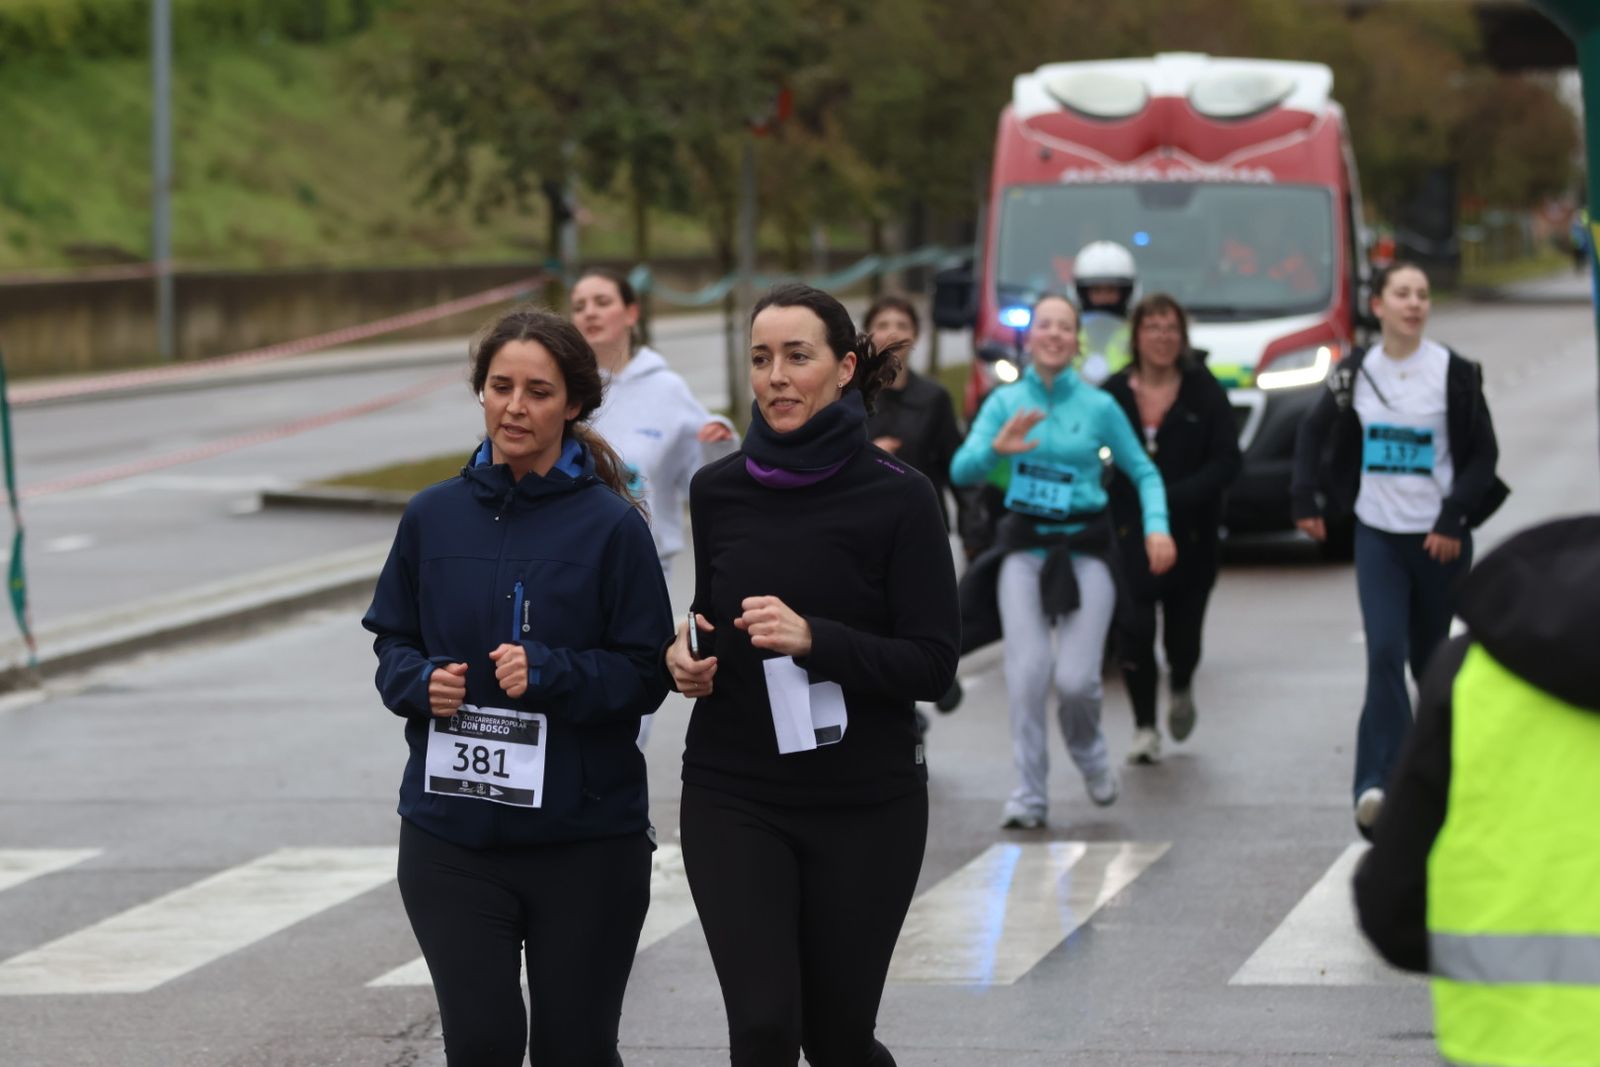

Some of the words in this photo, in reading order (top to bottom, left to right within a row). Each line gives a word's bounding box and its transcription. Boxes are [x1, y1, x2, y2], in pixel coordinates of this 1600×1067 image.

[461, 721, 478, 731] DON
[480, 723, 510, 735] BOSCO
[475, 716, 500, 726] CARRERA
[452, 742, 510, 779] 381
